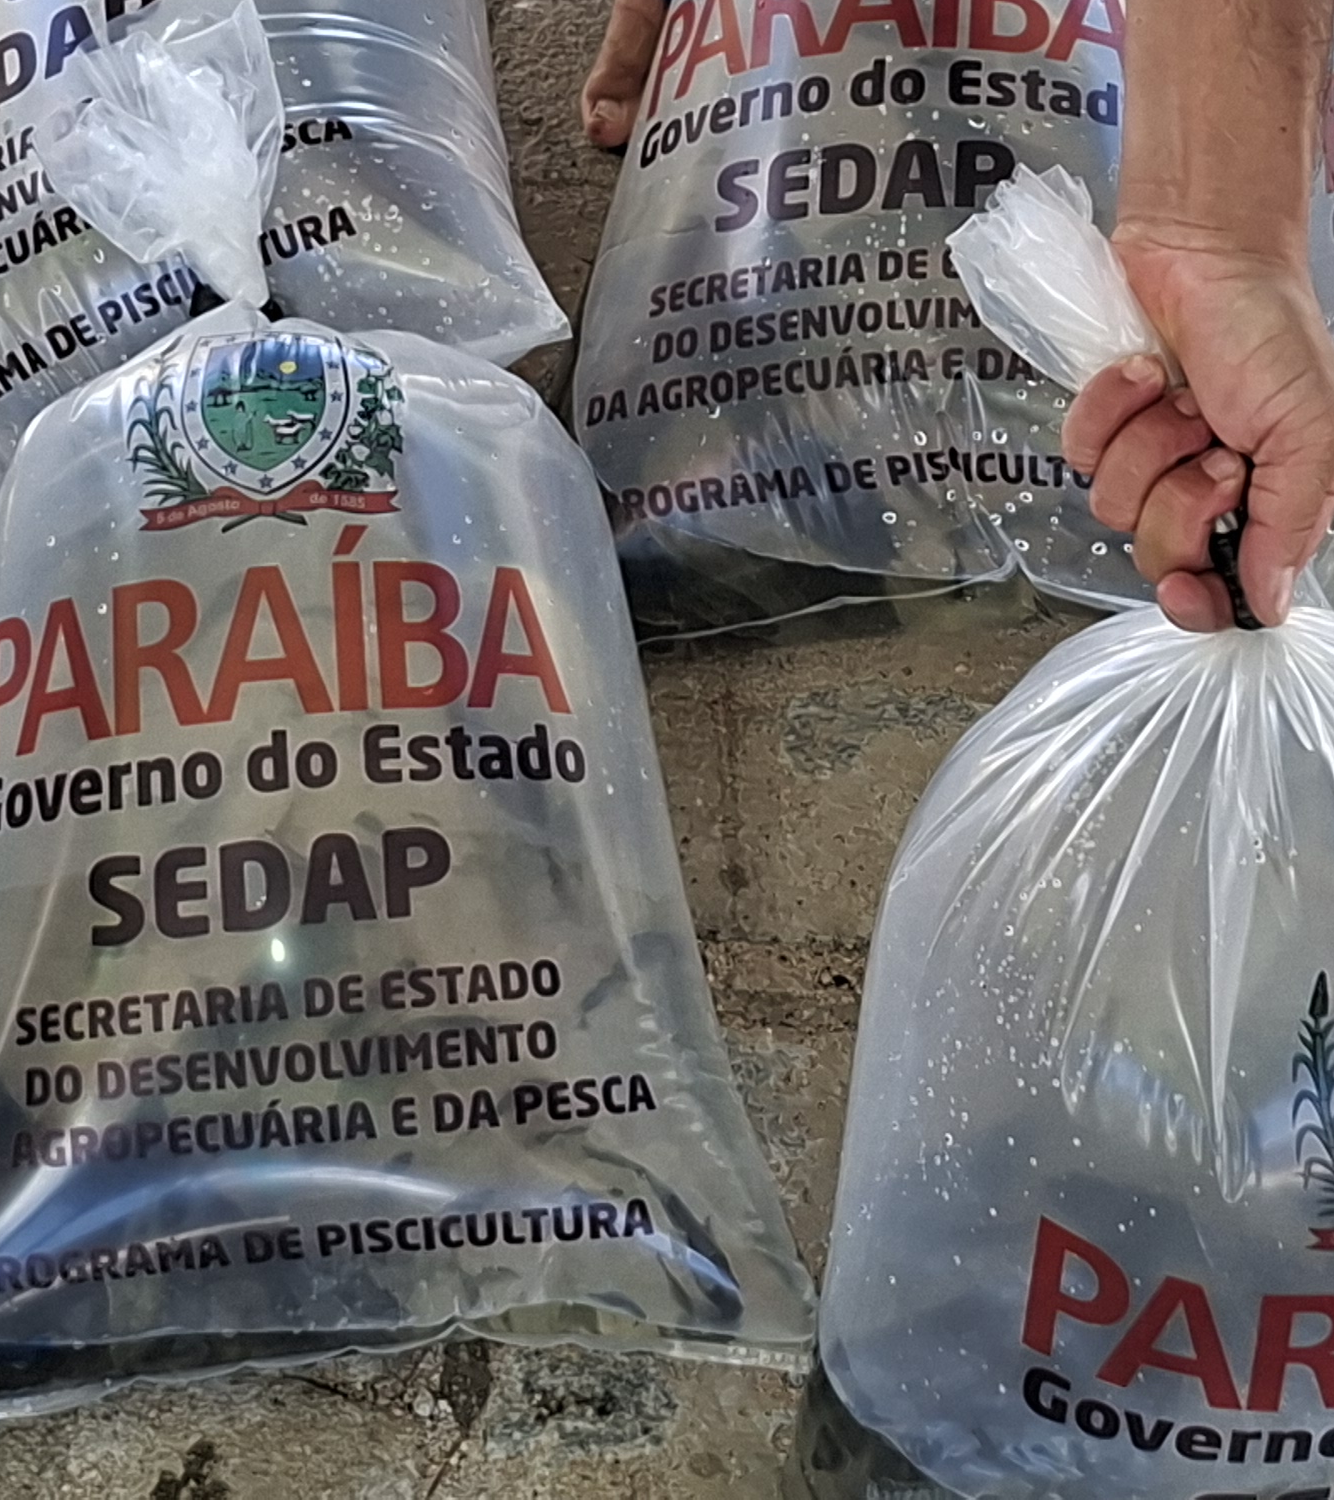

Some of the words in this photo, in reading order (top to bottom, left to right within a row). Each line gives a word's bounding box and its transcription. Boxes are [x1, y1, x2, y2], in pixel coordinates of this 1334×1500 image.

[639, 74, 831, 169] Governo
[849, 58, 925, 107] do
[948, 60, 1119, 127] Estad
[714, 139, 1017, 233] SEDAP
[649, 251, 866, 318] SECRETARIA
[878, 248, 928, 282] DE
[44, 314, 98, 360] DE
[652, 331, 698, 364] DO
[710, 297, 981, 350] DESENVOLVIM
[585, 391, 628, 428] DA
[637, 346, 929, 417] AGROPECUÁRIA
[942, 347, 966, 380] E
[824, 457, 877, 494] DE
[246, 729, 340, 793] do
[363, 723, 587, 784] Estado
[88, 827, 452, 948] SEDAP
[15, 982, 289, 1047] SECRETARIA
[303, 976, 365, 1018] DE
[380, 958, 562, 1012] ESTADO
[25, 1062, 83, 1107] DO
[97, 1020, 559, 1102] DESENVOLVIMENTO
[12, 1093, 377, 1171] AGROPECUÁRIA
[392, 1095, 417, 1136] E
[434, 1087, 501, 1132] DA
[515, 1073, 656, 1125] PESCA
[243, 1224, 304, 1267] DE
[318, 1197, 655, 1257] PISCICULTURA
